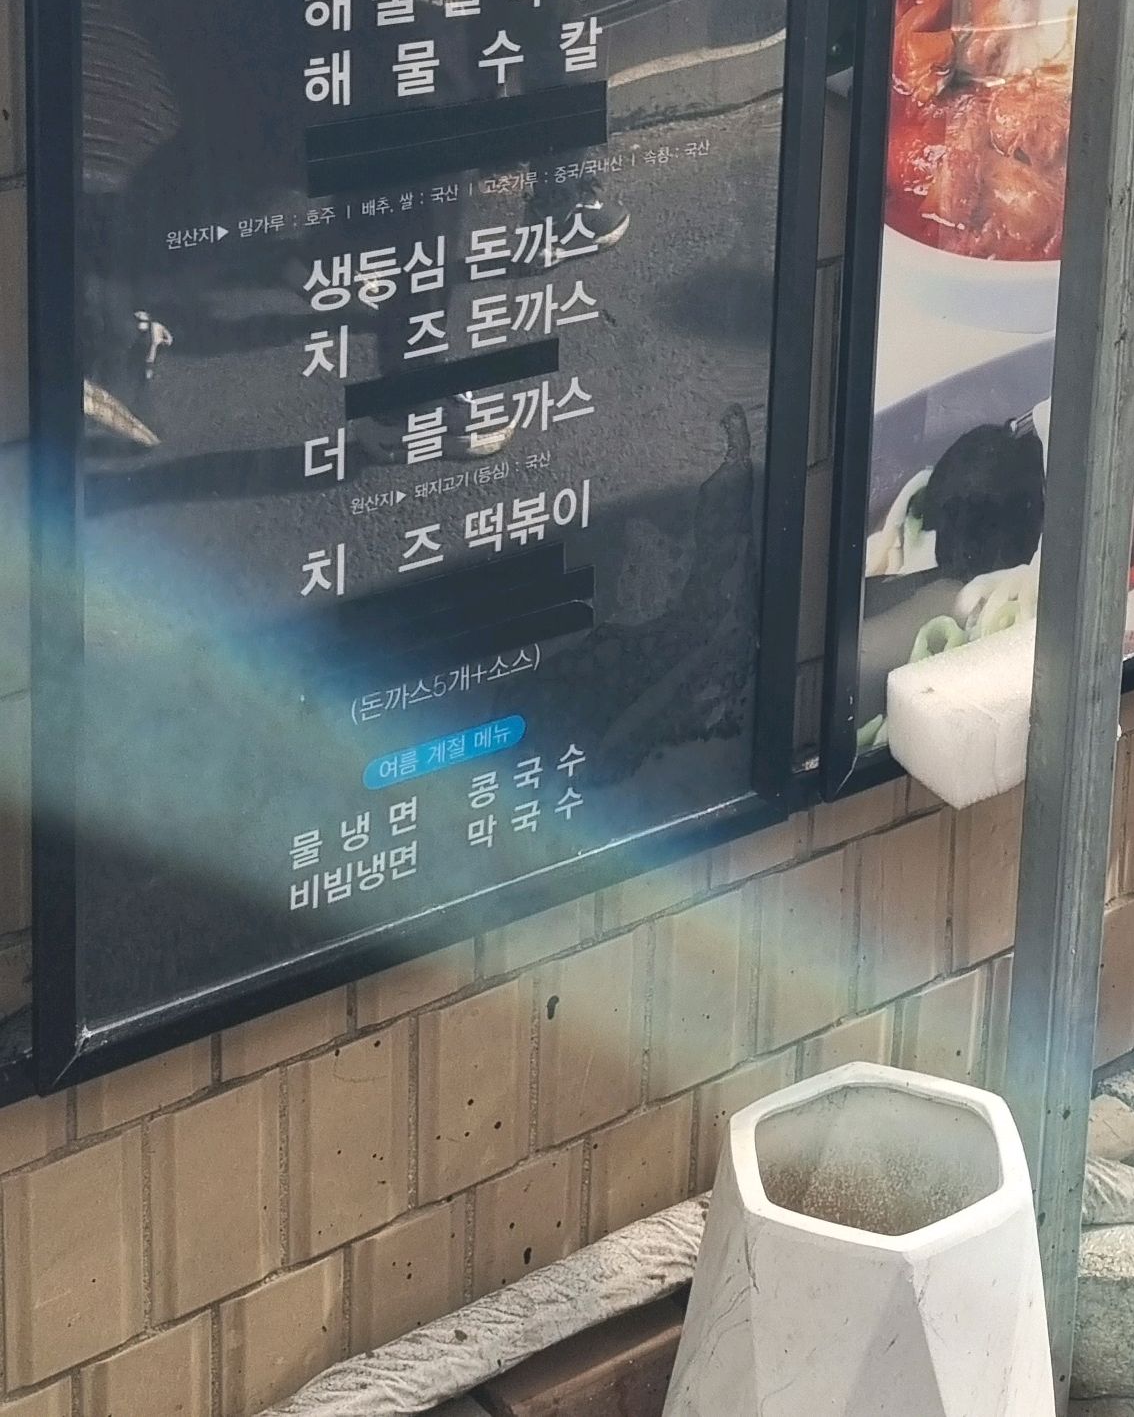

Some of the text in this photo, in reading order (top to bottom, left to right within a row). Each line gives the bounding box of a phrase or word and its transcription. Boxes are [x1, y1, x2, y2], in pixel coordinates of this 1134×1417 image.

[238, 214, 285, 238] 밀가루
[304, 206, 336, 227] 호주
[399, 192, 414, 211] 쌀
[430, 184, 459, 203] 국산
[554, 155, 624, 184] 중국/국내산
[684, 139, 711, 158] 국산
[303, 212, 600, 311] 생등심 돈까스
[466, 280, 600, 349] 돈까스
[465, 376, 595, 450] 돈까스
[525, 450, 551, 470] 국산
[464, 479, 590, 552] 떡볶이
[379, 724, 511, 778] 여름 계절 메뉴
[289, 840, 418, 911] 비빔냉면
